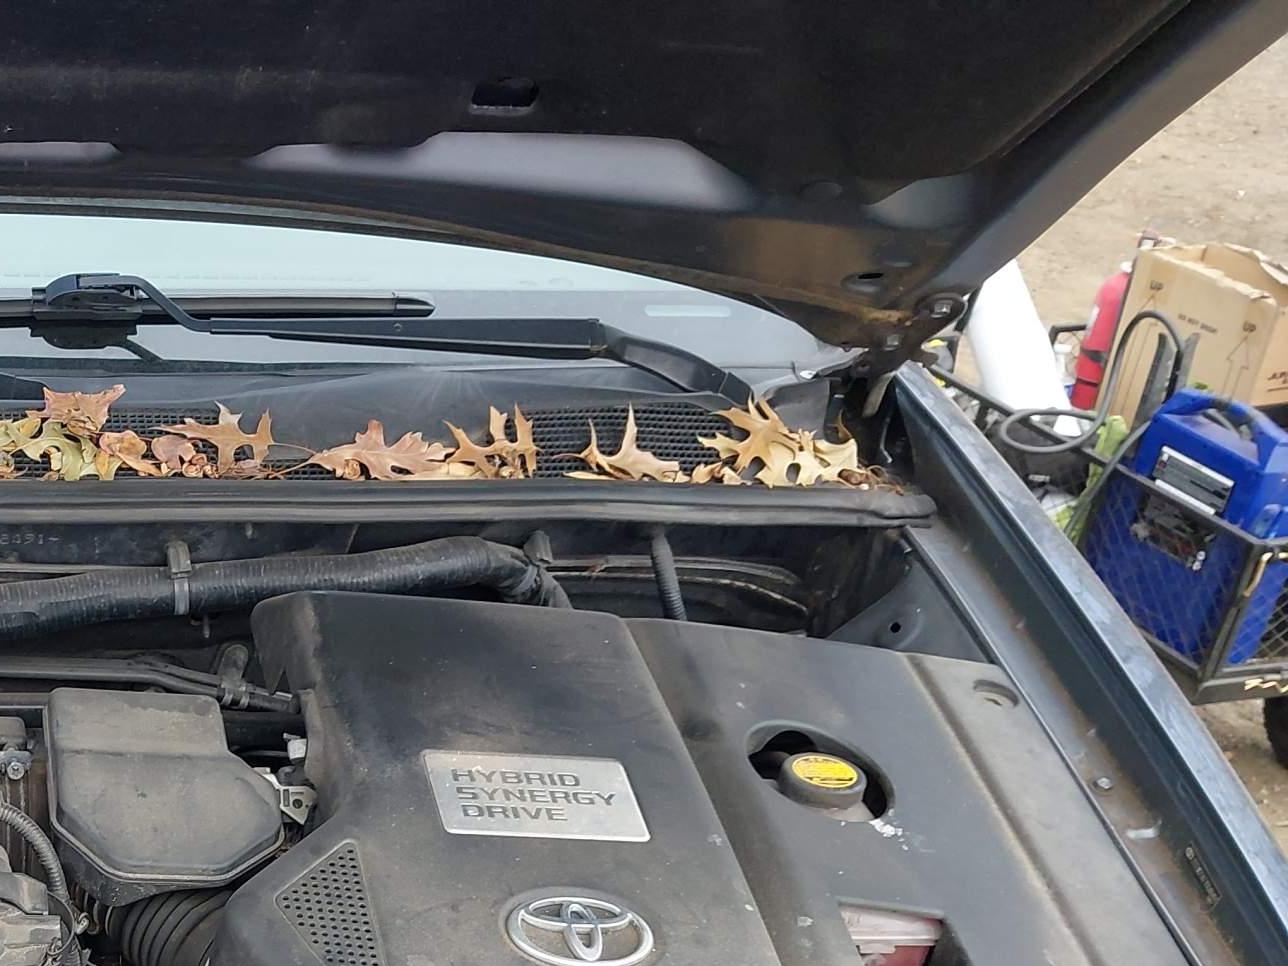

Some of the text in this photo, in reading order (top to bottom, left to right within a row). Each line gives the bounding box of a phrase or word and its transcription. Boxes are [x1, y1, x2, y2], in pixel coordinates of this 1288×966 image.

[450, 768, 581, 787] HYBRID
[455, 786, 617, 806] SYNERGY
[462, 804, 569, 821] DRIVE
